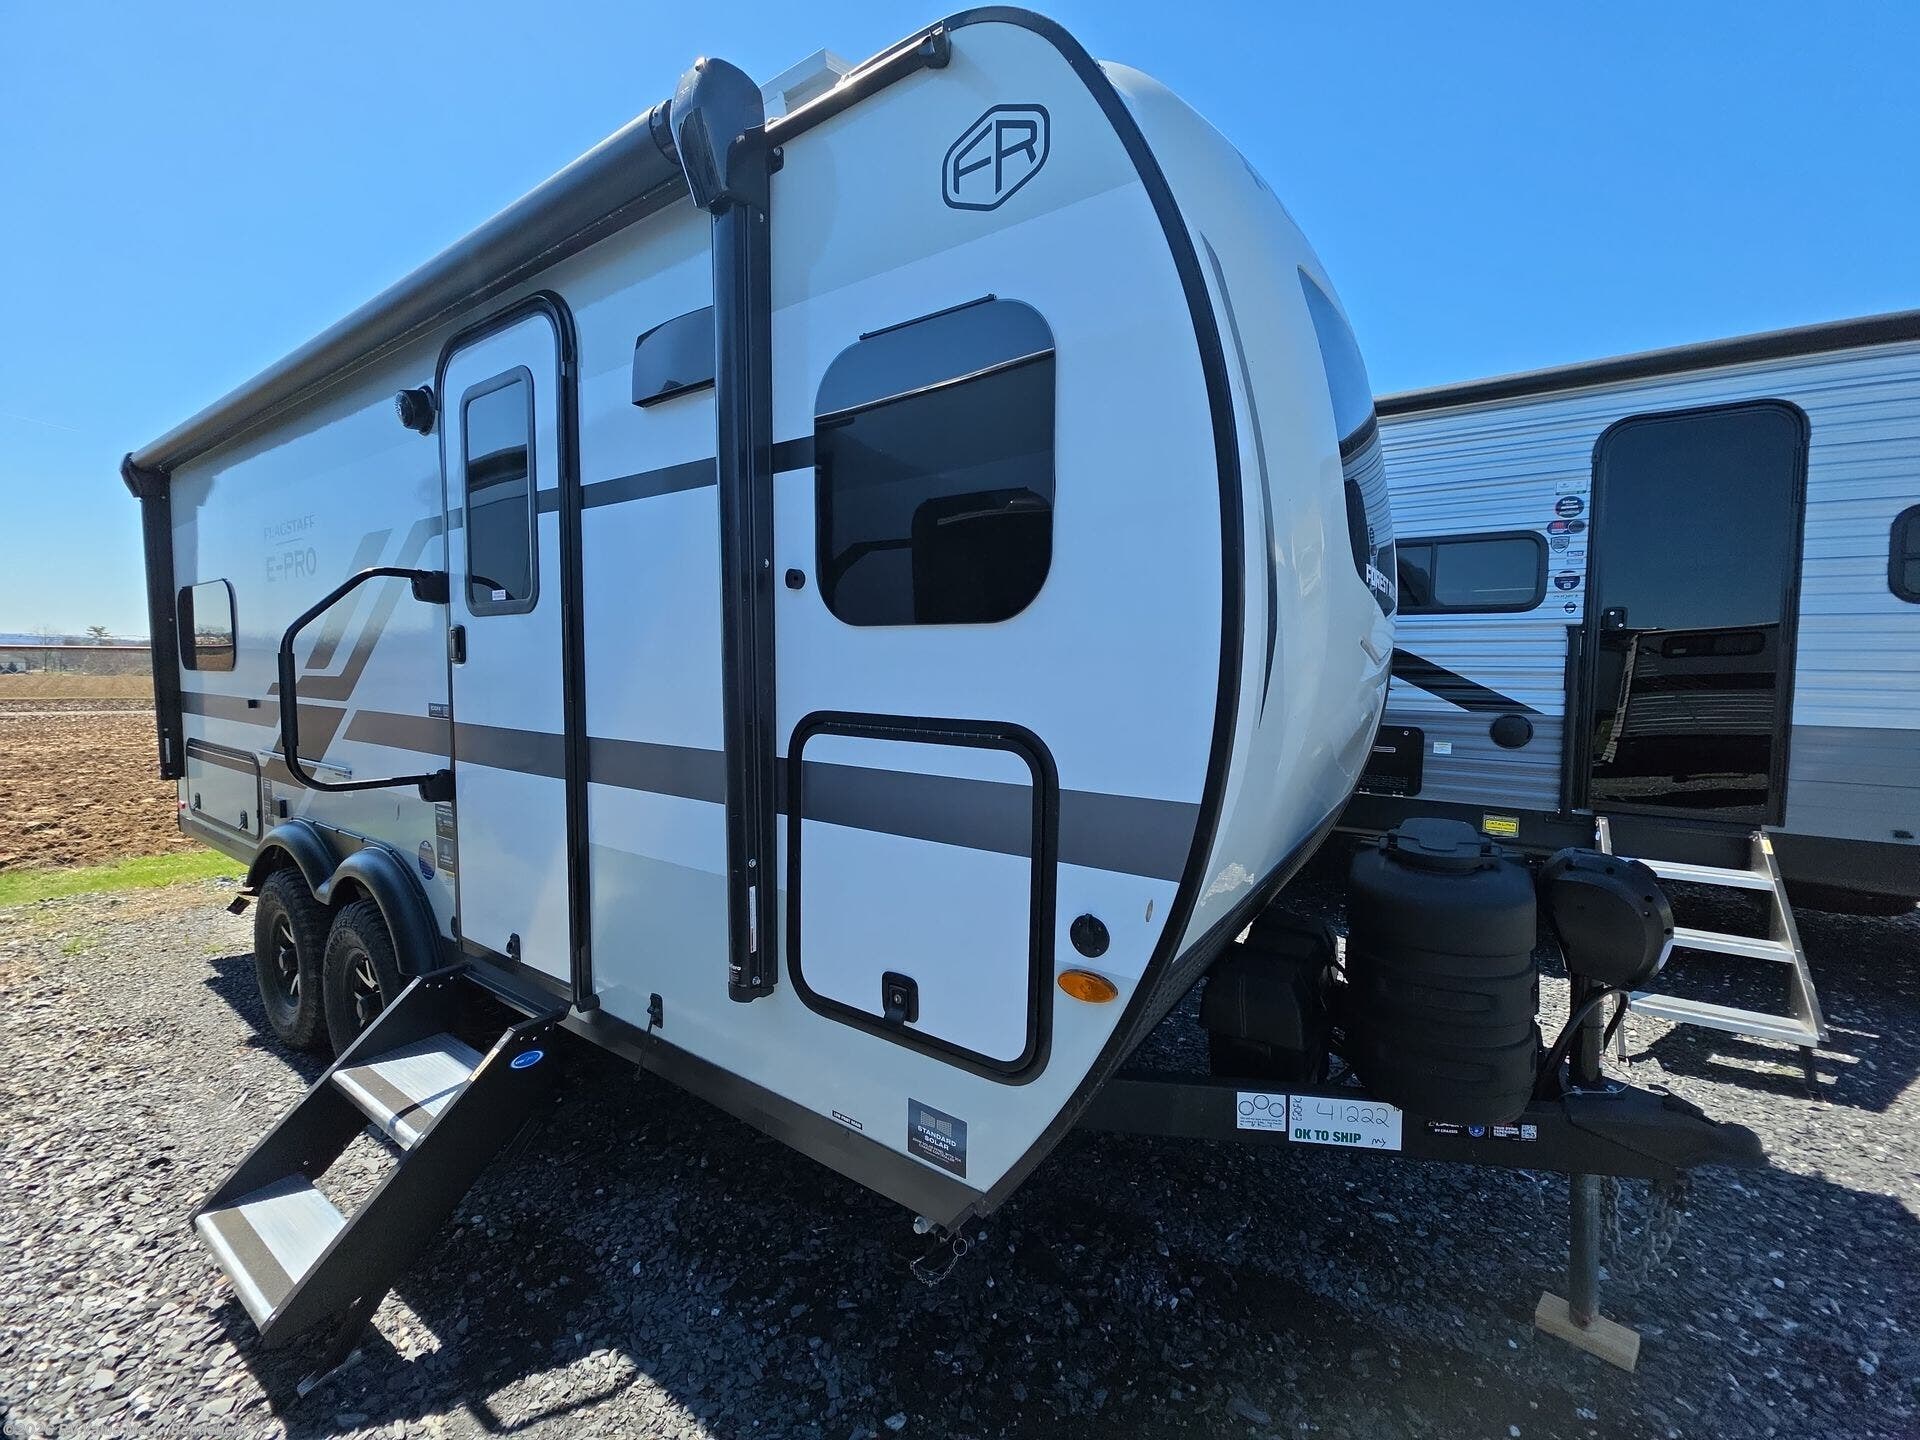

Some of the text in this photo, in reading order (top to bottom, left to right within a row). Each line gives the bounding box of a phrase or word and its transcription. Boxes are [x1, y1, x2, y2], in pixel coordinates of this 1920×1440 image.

[263, 513, 316, 539] FLAGSTAFF
[264, 547, 317, 582] E-PRO
[1316, 1102, 1390, 1128] 41222
[917, 1125, 957, 1147] STANDARD
[924, 1135, 949, 1151] SOLAR
[1294, 1127, 1362, 1144] OK TO SHIP
